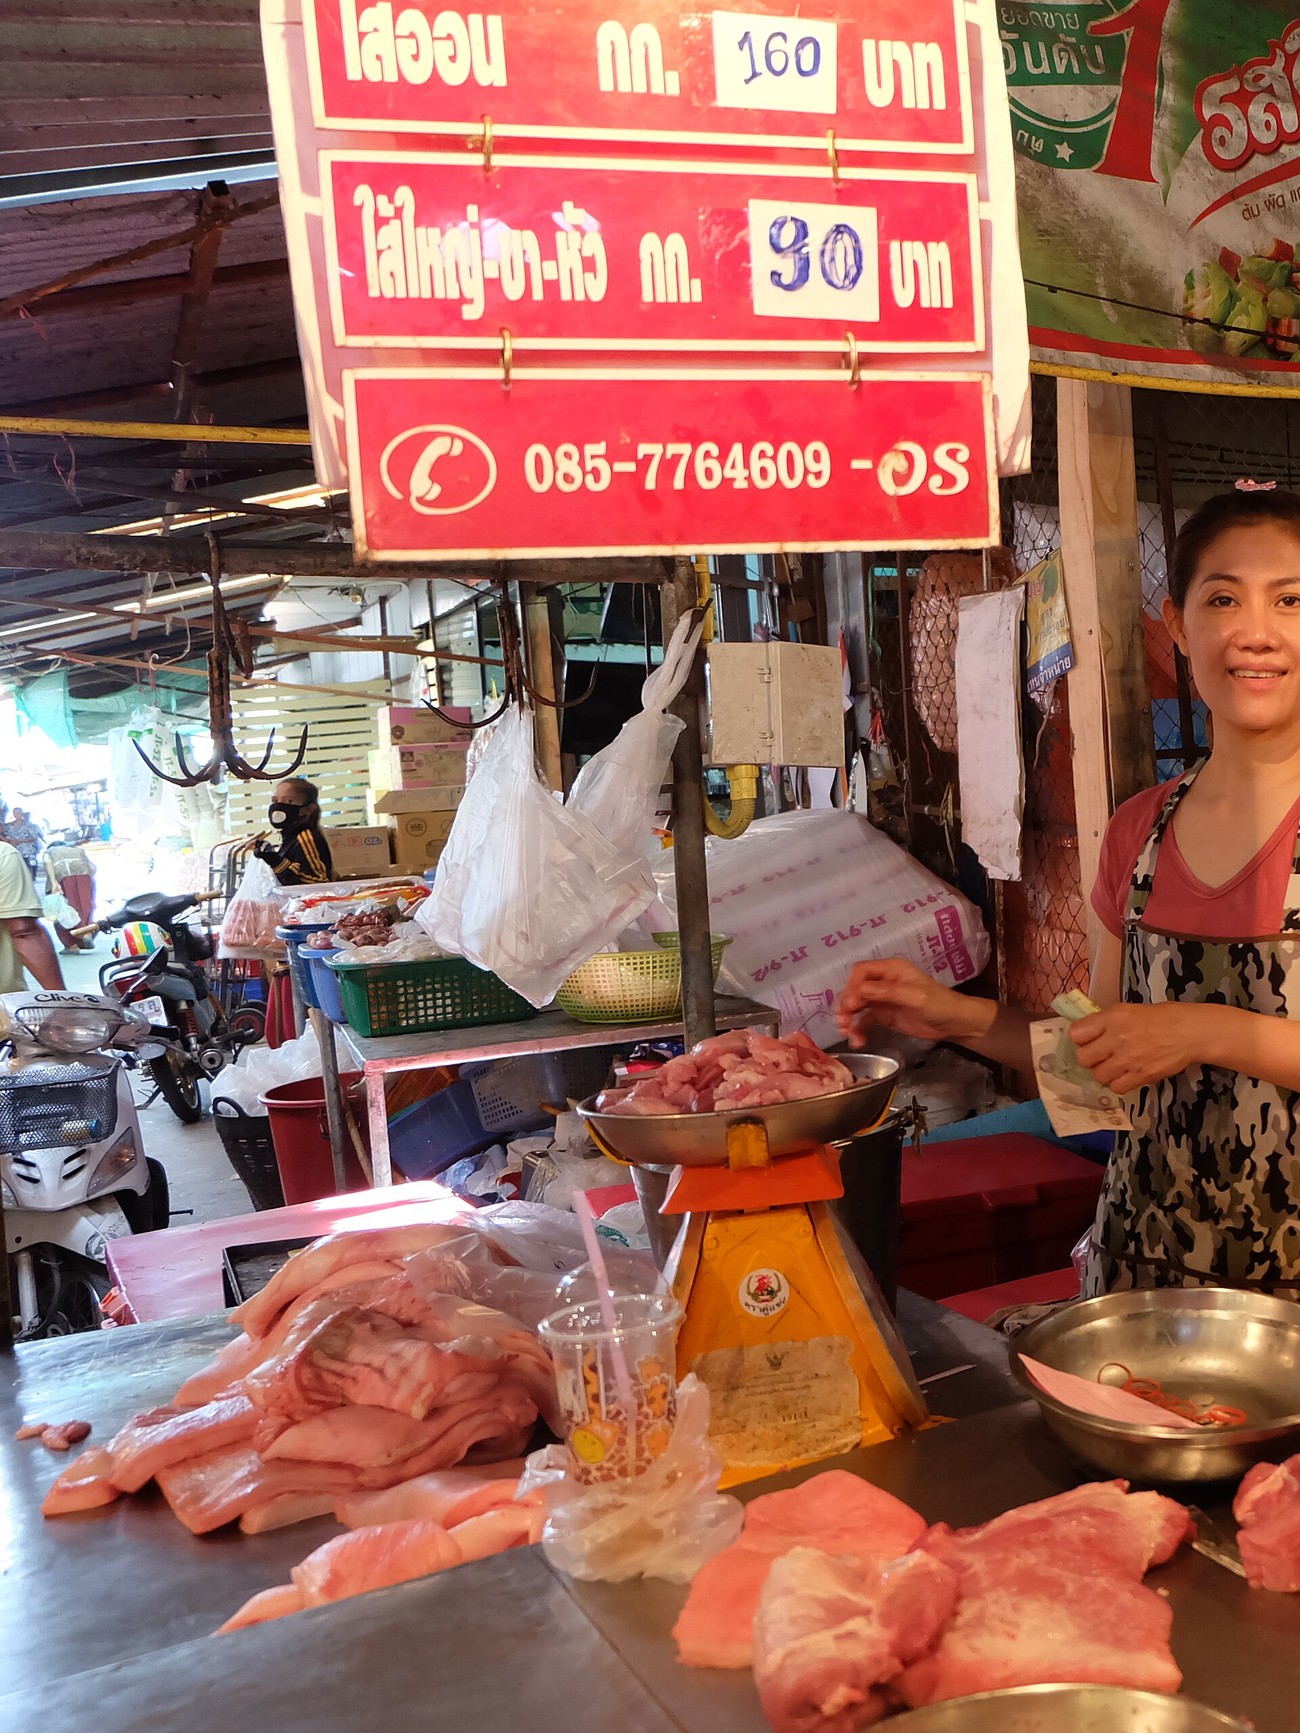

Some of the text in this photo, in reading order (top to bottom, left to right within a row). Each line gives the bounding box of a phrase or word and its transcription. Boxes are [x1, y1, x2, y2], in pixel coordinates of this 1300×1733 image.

[596, 20, 681, 96] กก.
[737, 30, 821, 85] 160
[862, 38, 947, 110] บาท
[640, 232, 703, 303] กก.
[768, 215, 864, 292] 90
[889, 240, 954, 309] บาท
[524, 440, 832, 493] 085-7764609
